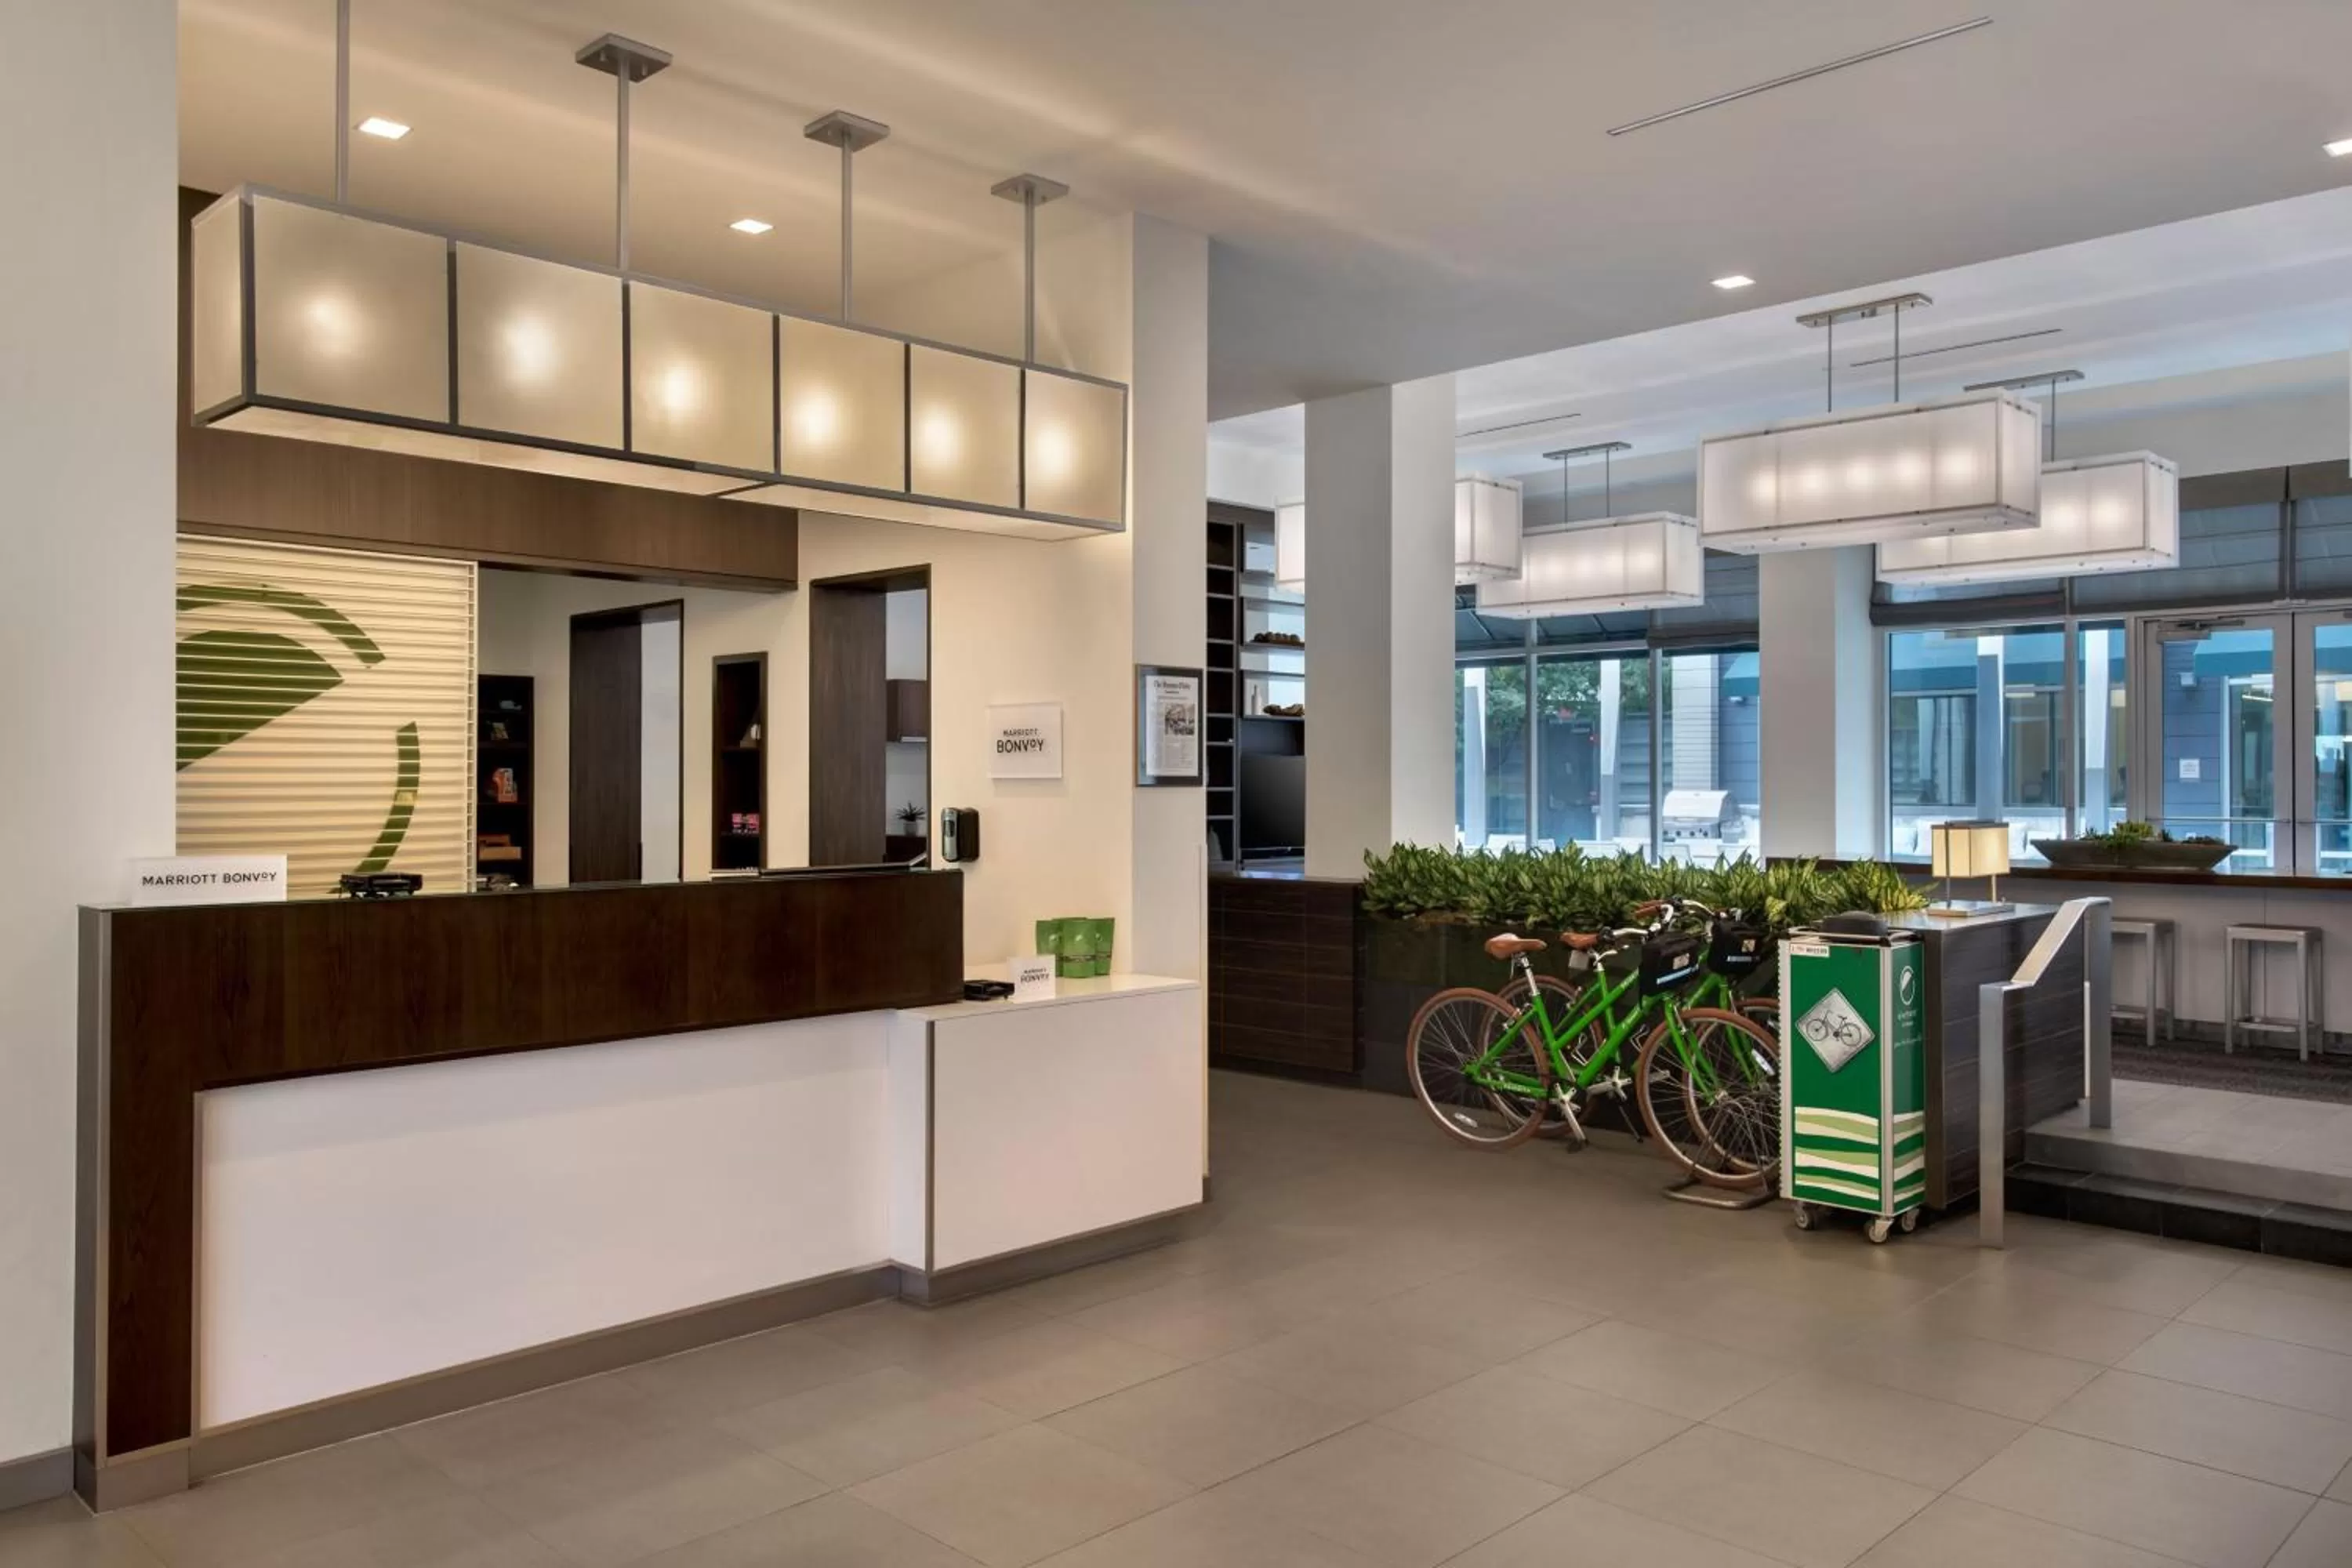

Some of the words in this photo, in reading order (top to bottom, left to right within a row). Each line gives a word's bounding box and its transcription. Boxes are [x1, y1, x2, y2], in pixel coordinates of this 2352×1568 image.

[996, 738, 1044, 753] BONVOY
[142, 873, 216, 886] MARRIOTT
[222, 872, 277, 884] BONVOY
